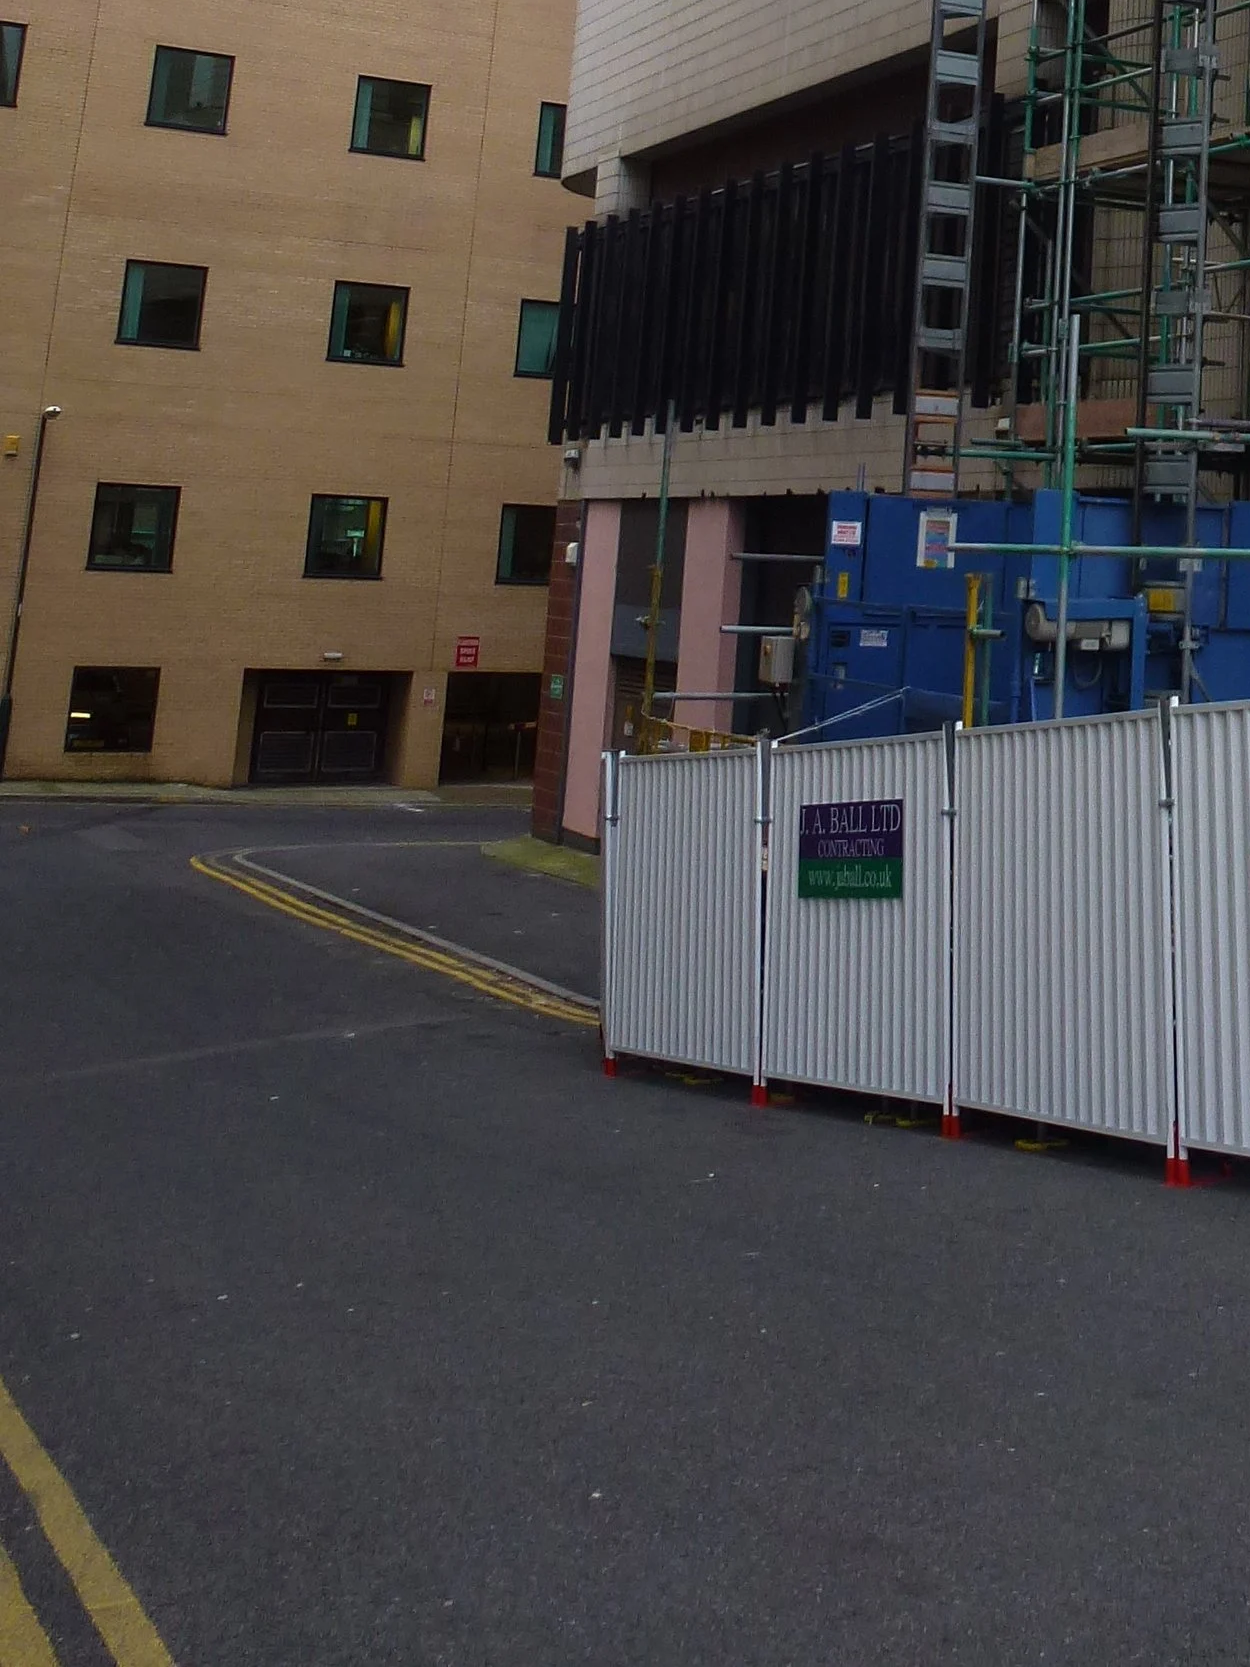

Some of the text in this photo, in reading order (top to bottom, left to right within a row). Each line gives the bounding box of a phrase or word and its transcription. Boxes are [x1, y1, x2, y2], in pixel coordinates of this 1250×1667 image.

[812, 807, 826, 834] A.
[830, 805, 868, 834] BALL
[871, 803, 901, 832] LTD
[817, 837, 885, 858] CONTRACTING
